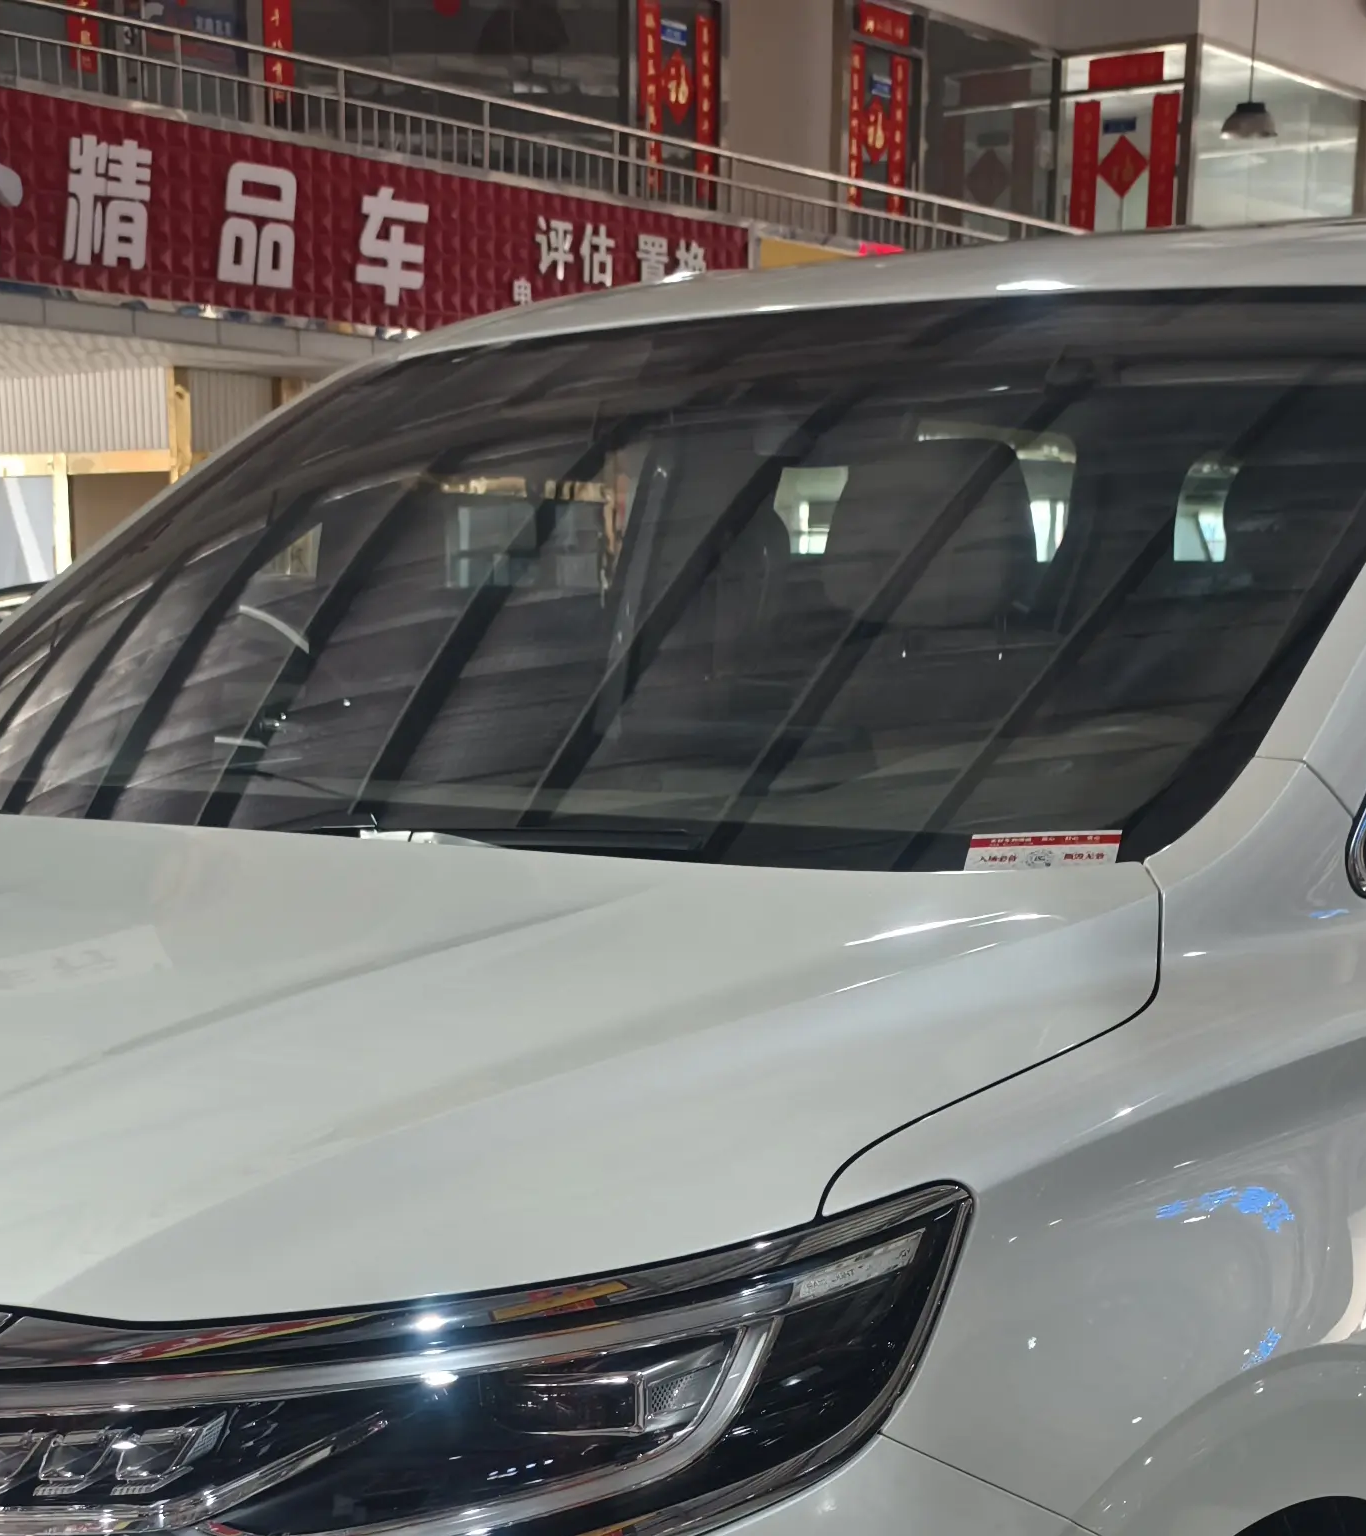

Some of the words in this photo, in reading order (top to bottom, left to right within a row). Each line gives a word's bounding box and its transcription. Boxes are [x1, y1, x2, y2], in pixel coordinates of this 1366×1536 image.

[63, 133, 430, 306] 精品车
[536, 215, 616, 288] 评估
